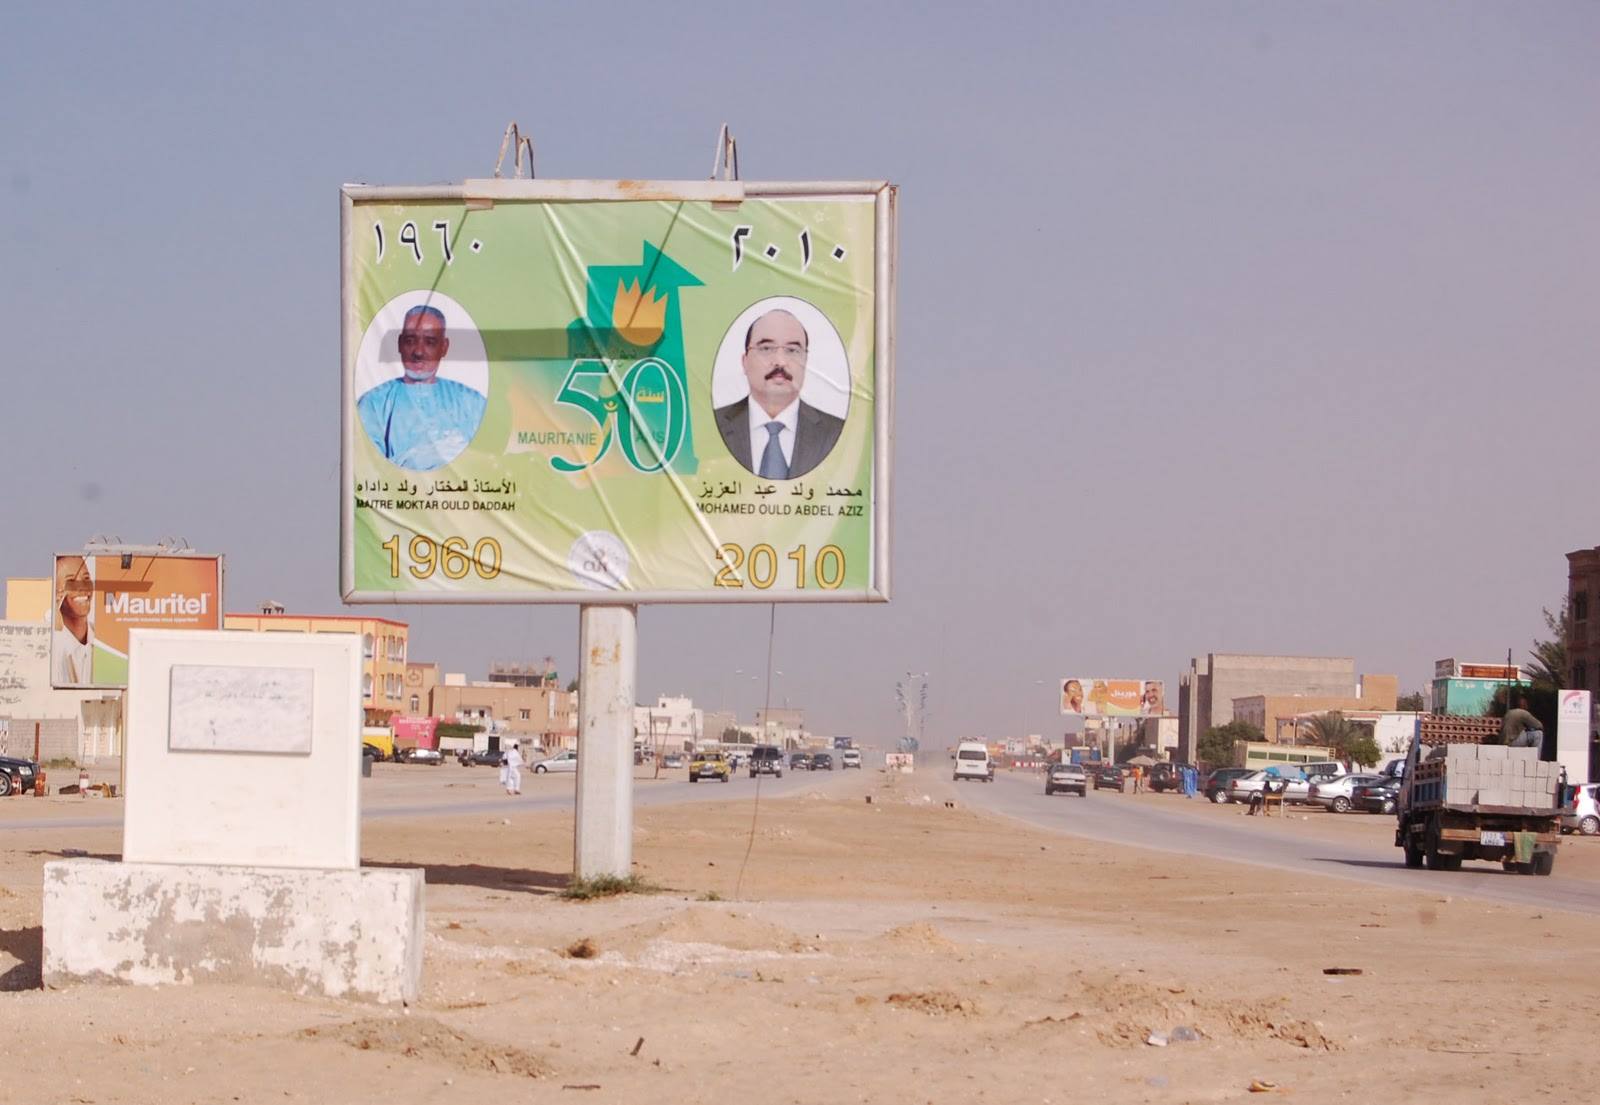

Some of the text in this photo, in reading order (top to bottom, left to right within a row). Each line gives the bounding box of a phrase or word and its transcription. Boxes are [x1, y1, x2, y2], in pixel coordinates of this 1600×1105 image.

[551, 357, 686, 473] 50
[518, 431, 597, 445] MAURITANIE
[356, 480, 389, 492] داداه
[397, 480, 417, 495] ولد
[699, 480, 863, 500] محمد ولد عبد العزيز
[396, 500, 439, 510] MOKTAR
[441, 500, 470, 510] OULD
[472, 501, 515, 511] DADDAH
[696, 503, 863, 517] MOHAMED OULD ABDEL AZIZ
[382, 534, 503, 580] 1960
[713, 543, 846, 589] 2010
[105, 591, 208, 615] Mauritel
